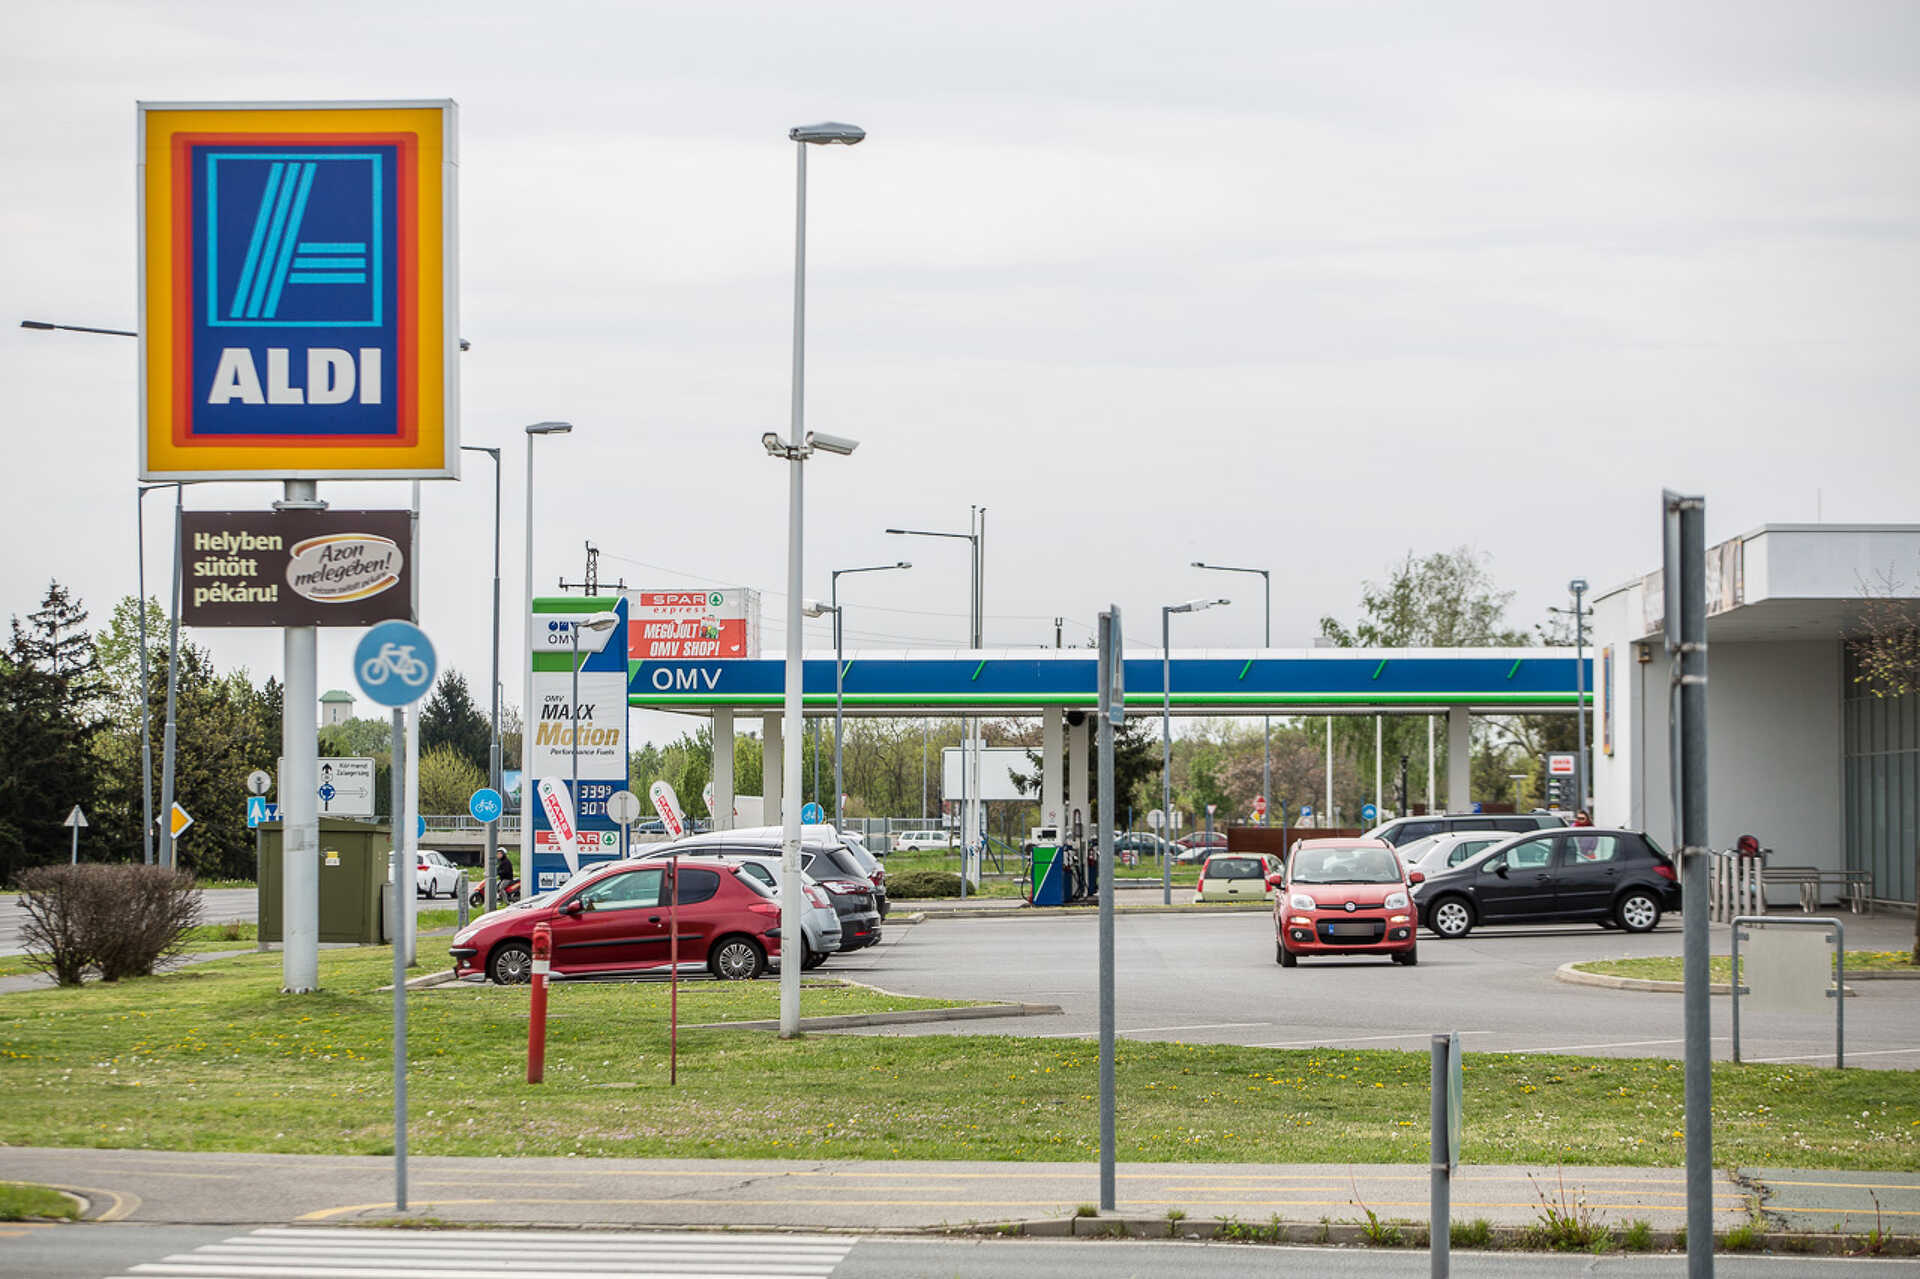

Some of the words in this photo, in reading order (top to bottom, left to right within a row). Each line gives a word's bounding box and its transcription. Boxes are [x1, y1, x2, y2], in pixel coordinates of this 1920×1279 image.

[208, 348, 381, 404] ALDI
[194, 531, 282, 555] Helyben
[320, 545, 364, 564] Azon
[194, 556, 258, 576] sütött
[295, 551, 392, 586] melegében!
[194, 581, 278, 607] pékáru!
[653, 595, 704, 605] SPAR
[653, 606, 706, 615] express
[649, 641, 680, 656] OMV
[652, 667, 722, 690] OMV
[544, 695, 565, 703] OMV
[541, 704, 596, 720] MAXX
[536, 722, 620, 746] Motion
[581, 802, 608, 815] 307
[548, 833, 598, 844] SAR
